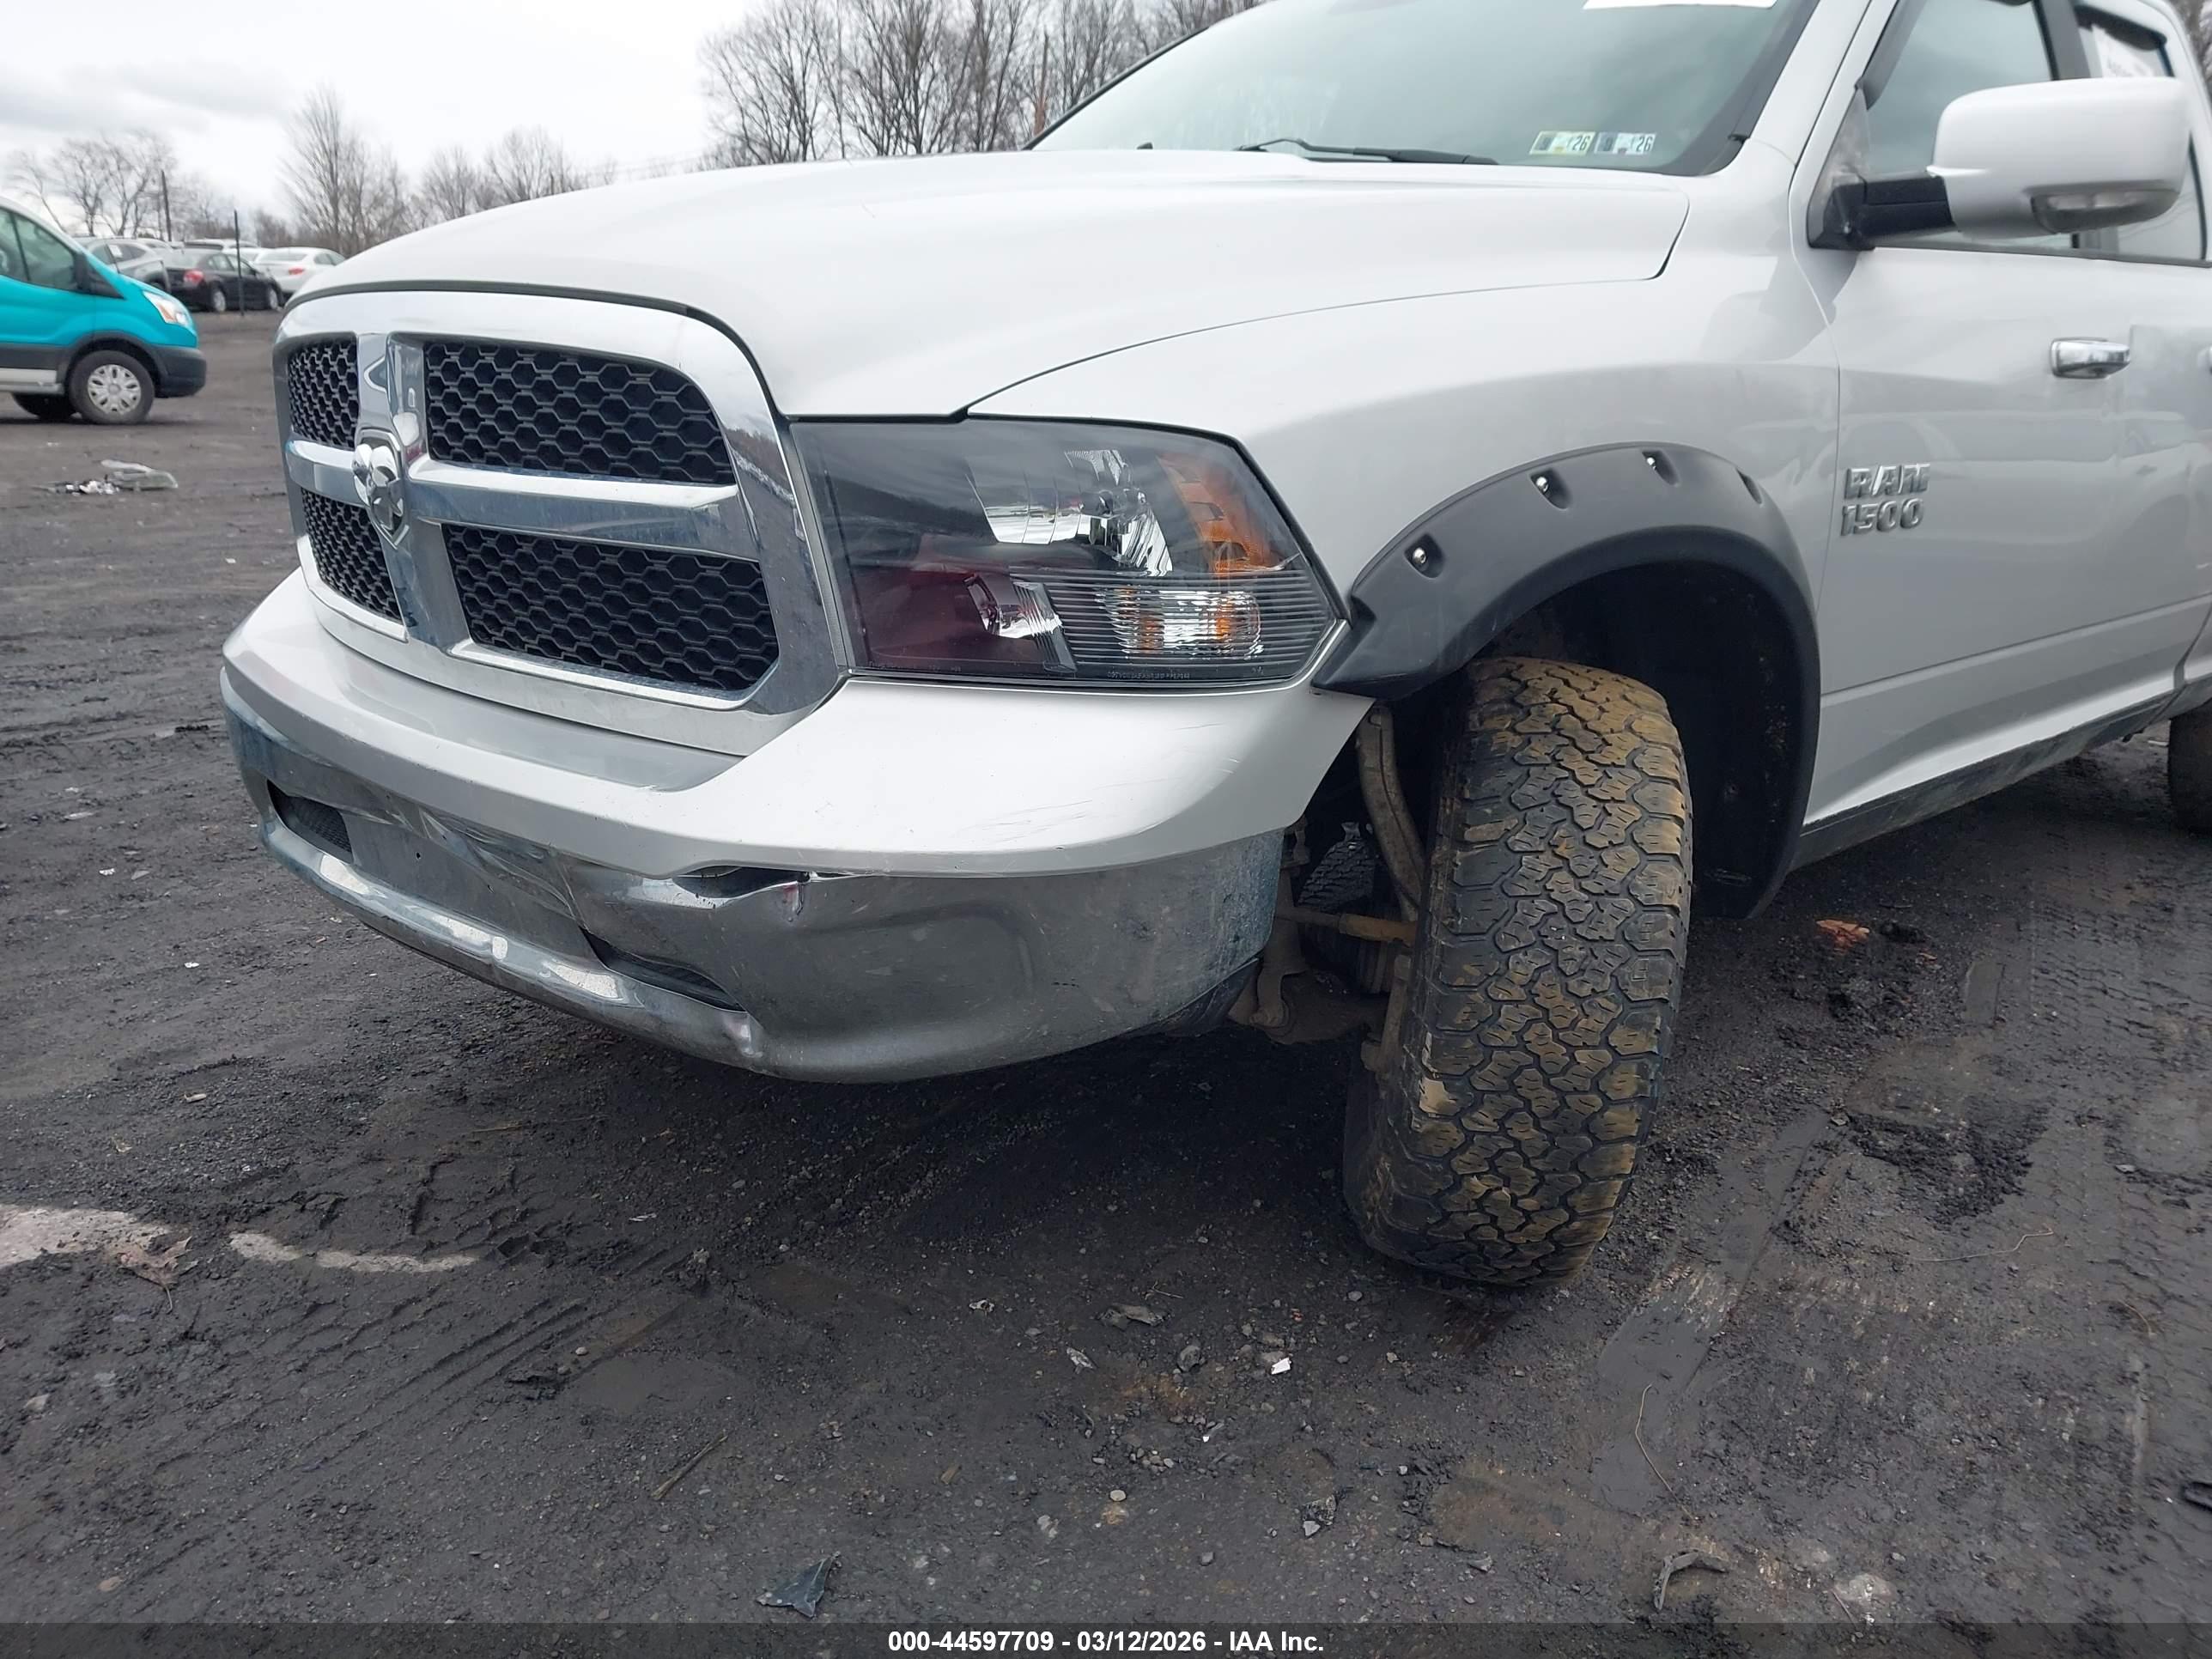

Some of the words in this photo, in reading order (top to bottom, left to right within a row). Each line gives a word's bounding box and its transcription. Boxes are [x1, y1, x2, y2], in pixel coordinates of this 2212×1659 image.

[1572, 136, 1590, 151] 26
[1636, 136, 1654, 151] 26
[1844, 463, 1930, 499] RAM
[1840, 498, 1923, 536] 1500
